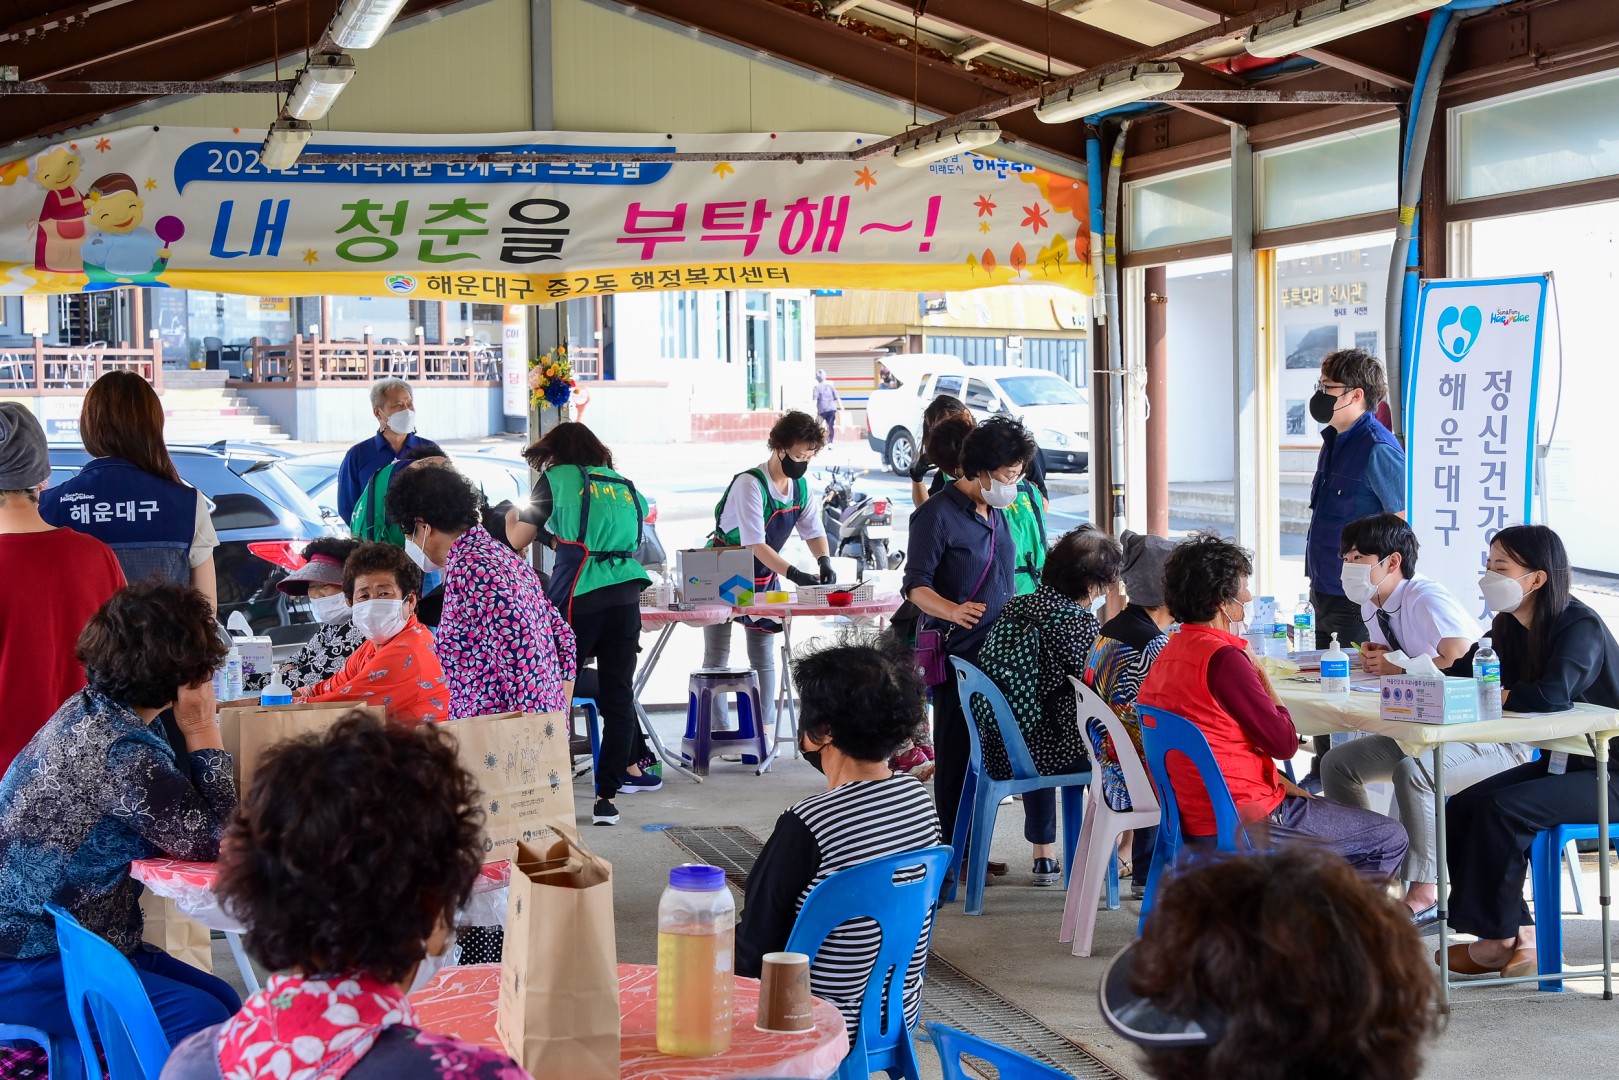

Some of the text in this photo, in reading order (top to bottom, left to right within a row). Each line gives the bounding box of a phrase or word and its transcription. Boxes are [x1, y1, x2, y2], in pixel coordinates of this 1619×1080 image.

[930, 164, 964, 175] 미래도시
[209, 198, 290, 259] 내
[335, 198, 571, 264] 청춘을
[426, 266, 790, 299] 해운대구 중2동 행정복지센터
[1434, 373, 1467, 546] 해운대구
[69, 500, 160, 525] 해운대구
